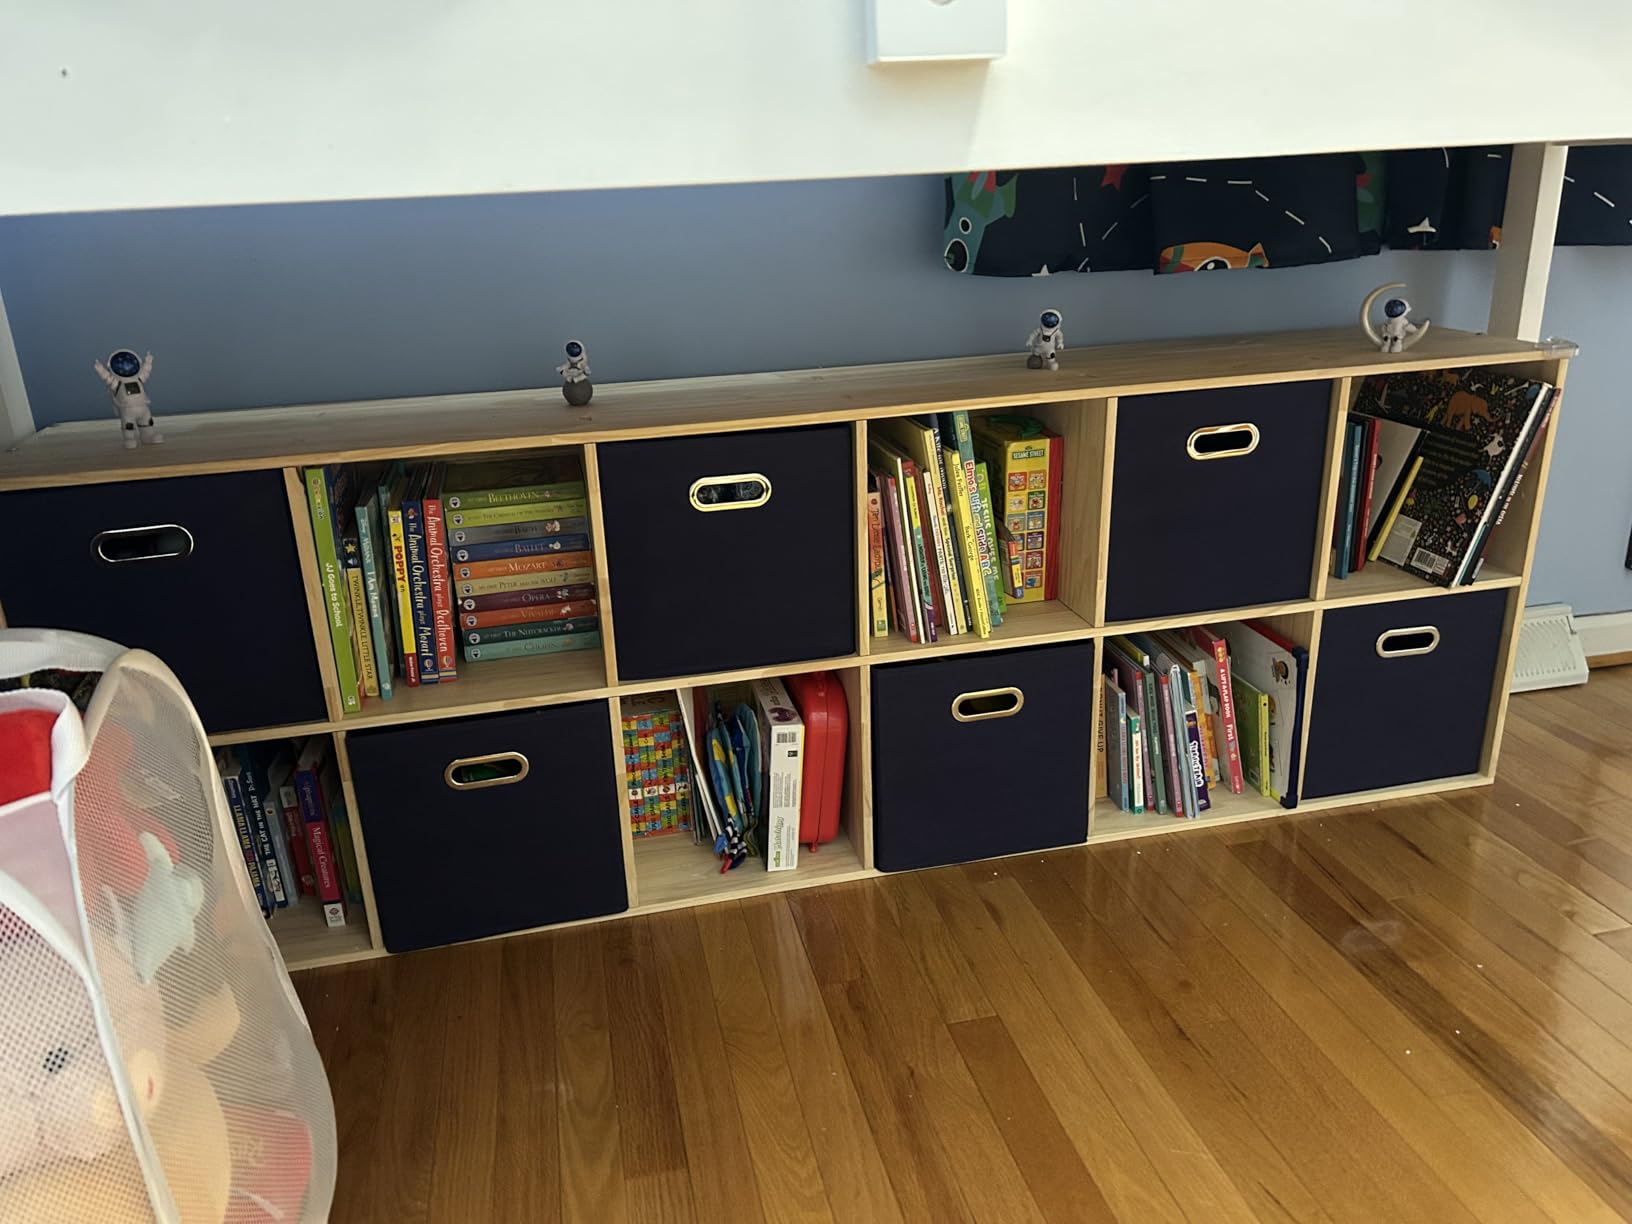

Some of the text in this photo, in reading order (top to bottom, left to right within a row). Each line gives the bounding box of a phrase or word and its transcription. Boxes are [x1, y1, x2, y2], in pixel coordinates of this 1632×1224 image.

[955, 478, 963, 496] Feiffer
[964, 460, 978, 493] Elmo's
[489, 490, 538, 502] BEETHOVEN
[970, 494, 982, 512] Lift
[428, 505, 436, 514] The
[980, 498, 990, 528] JESUS
[428, 517, 442, 545] Animal
[975, 528, 989, 552] Slide
[409, 535, 423, 563] Animal
[515, 543, 544, 552] BALLET
[966, 541, 974, 560] George
[326, 563, 333, 572] JJ
[395, 546, 405, 581] POPPY
[431, 548, 444, 590] Orchestra
[509, 561, 544, 571] MOZART
[979, 552, 991, 576] ABC
[331, 593, 337, 601] to
[413, 566, 426, 608] Orchestra
[522, 593, 549, 601] OPERA
[333, 602, 342, 626] School
[420, 627, 432, 655] Mozart
[437, 610, 449, 651] Beethoven
[361, 641, 370, 662] LITTLE
[1097, 740, 1103, 752] UP
[234, 805, 245, 826] LLAMA
[240, 828, 250, 848] LLAMA
[260, 831, 268, 841] CAT
[313, 828, 330, 888] Magical Creatures
